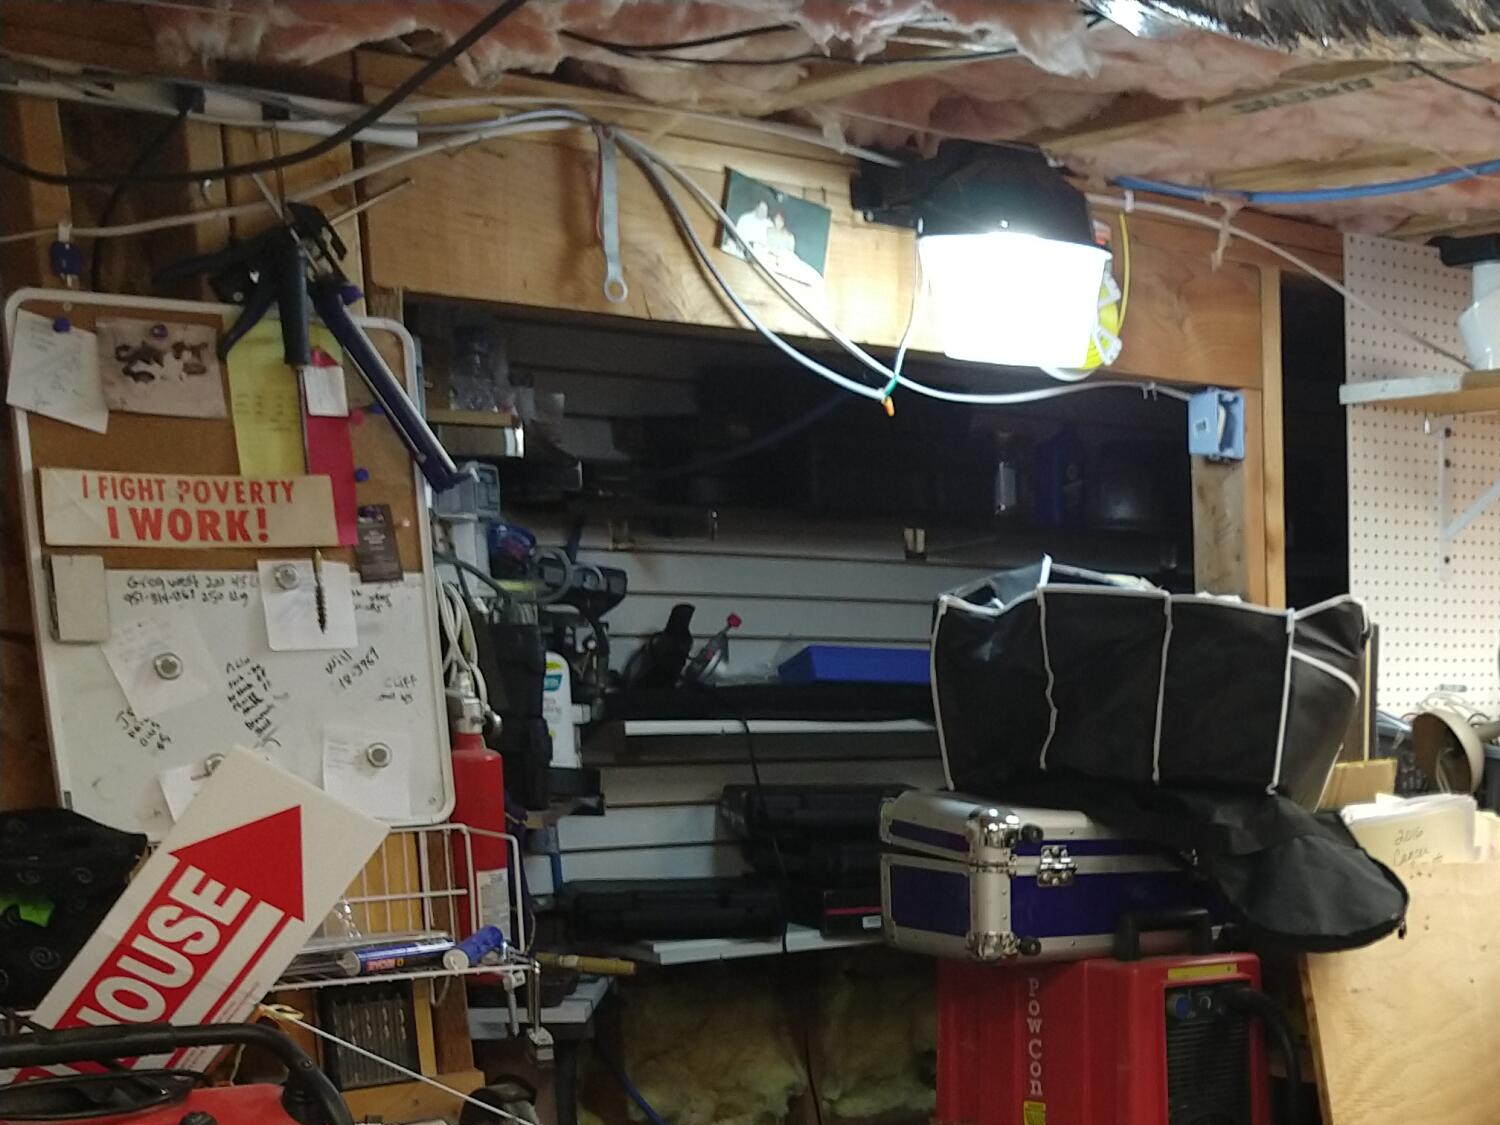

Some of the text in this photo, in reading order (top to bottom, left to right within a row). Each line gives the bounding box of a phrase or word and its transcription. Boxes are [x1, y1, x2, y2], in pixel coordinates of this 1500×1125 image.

[81, 474, 295, 505] I FIGHT POVERTY
[107, 506, 269, 544] I WORK!
